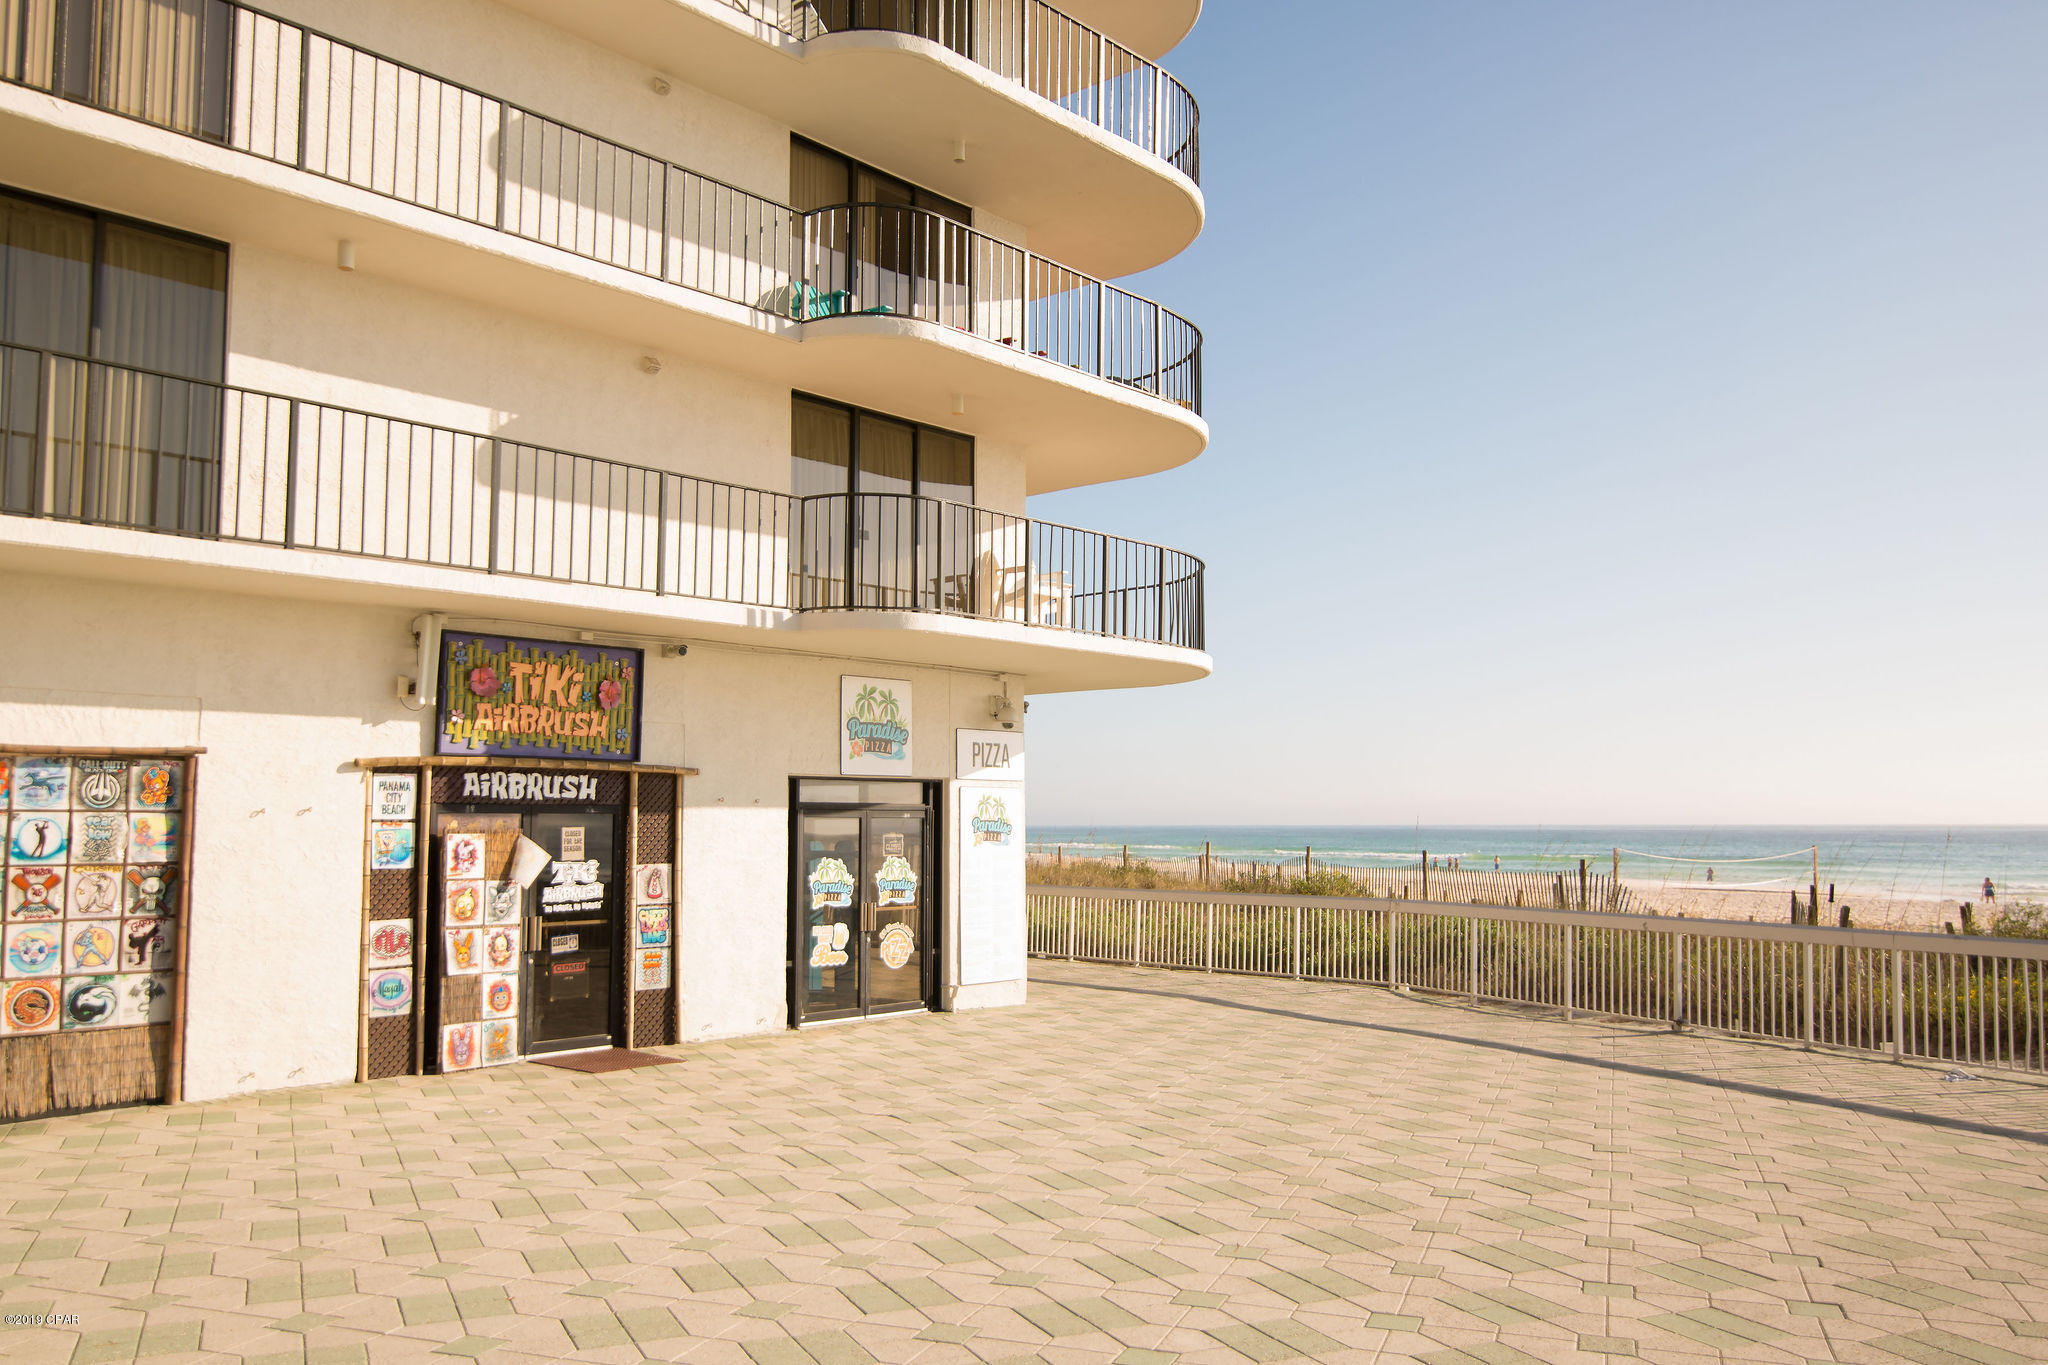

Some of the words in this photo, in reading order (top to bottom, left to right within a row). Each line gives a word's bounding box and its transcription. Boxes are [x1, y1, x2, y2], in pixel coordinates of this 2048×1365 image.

[509, 661, 585, 707] TiKi
[847, 717, 909, 745] Paradise
[865, 740, 892, 753] PIZZA
[972, 742, 1010, 768] PIZZA
[379, 781, 411, 791] PANAMA
[386, 792, 402, 803] CITY
[382, 804, 406, 815] BEACH
[972, 817, 1012, 836] Paradise
[983, 833, 1001, 842] PIZZA
[813, 880, 853, 896] Paradise
[879, 878, 915, 893] Paradise
[824, 893, 841, 901] PIZZA
[889, 890, 905, 898] PIZZA
[556, 963, 585, 972] CLOSED
